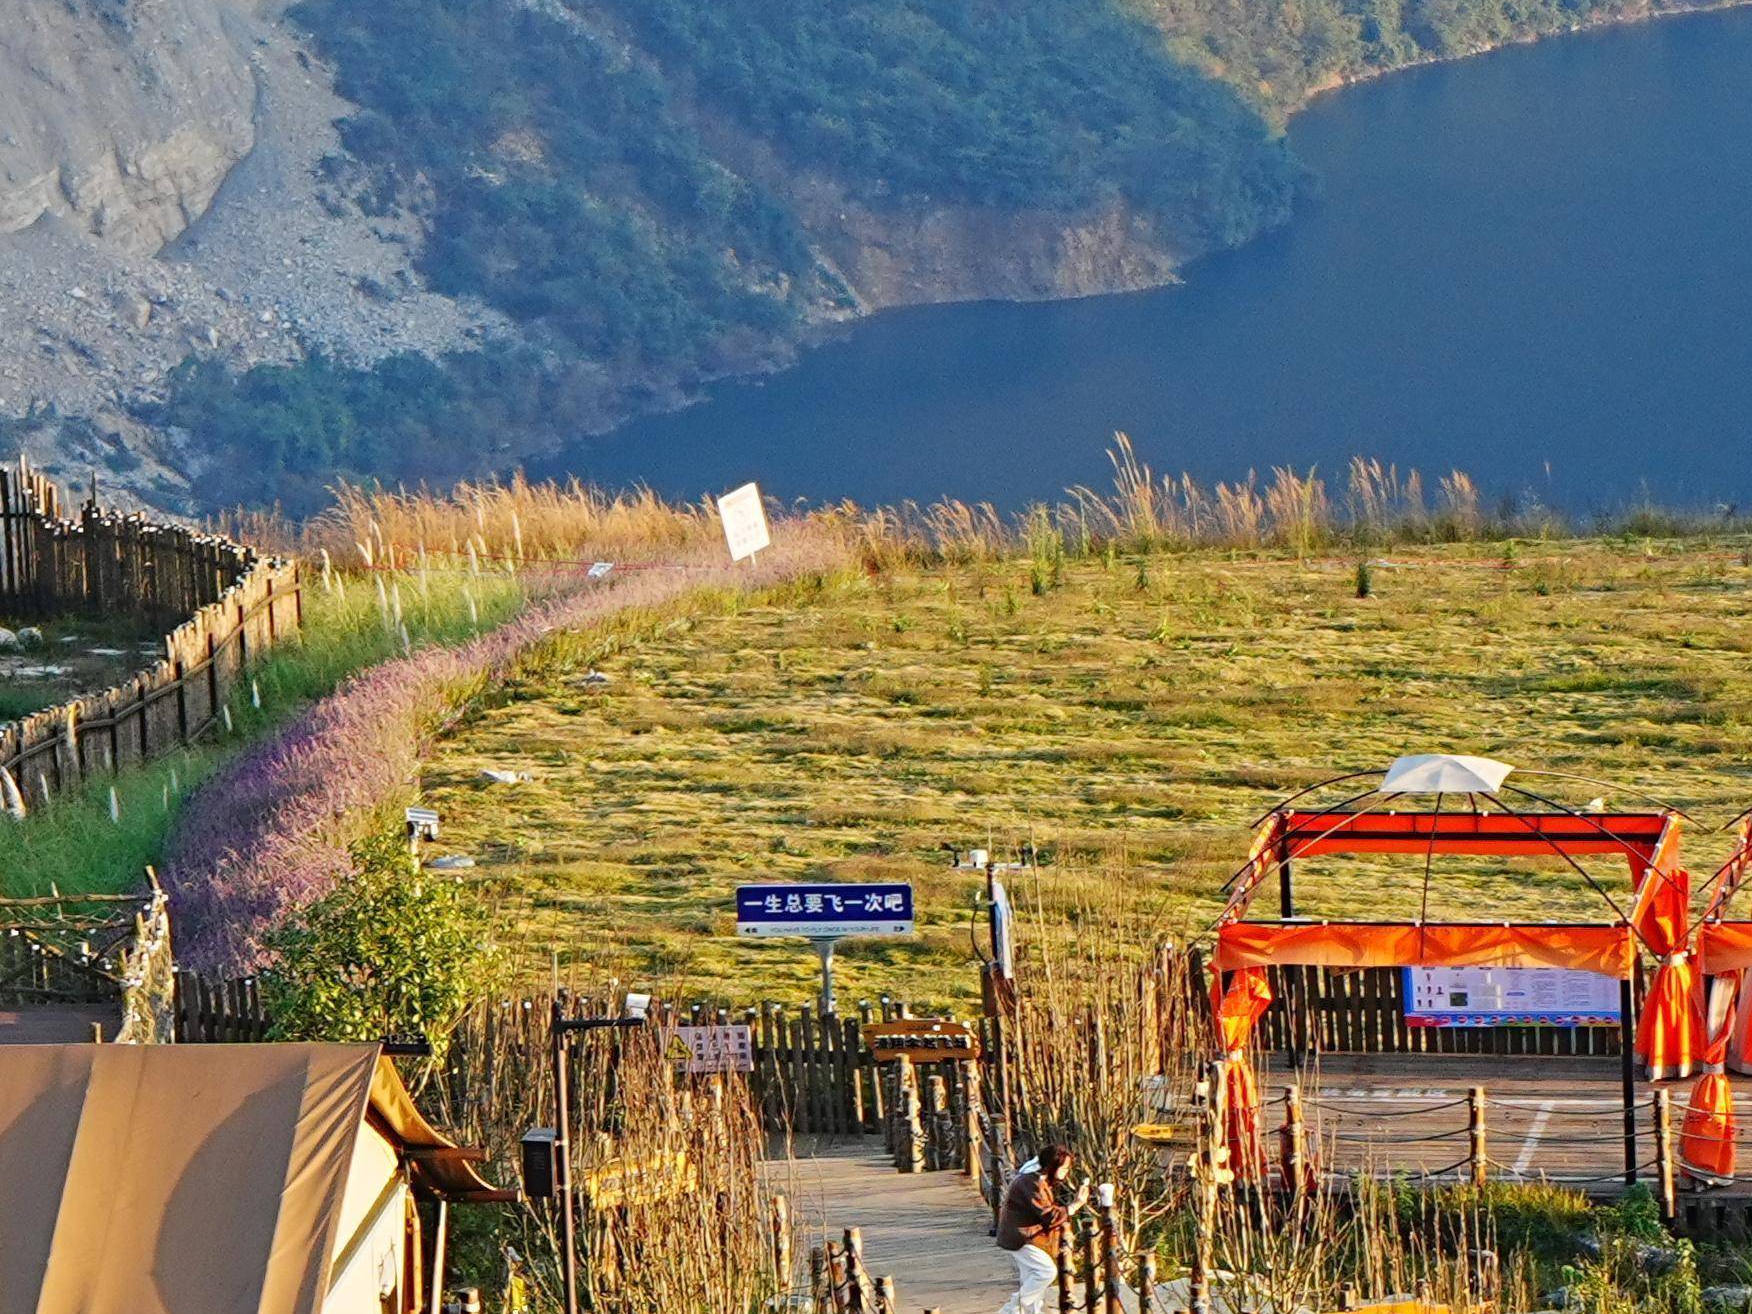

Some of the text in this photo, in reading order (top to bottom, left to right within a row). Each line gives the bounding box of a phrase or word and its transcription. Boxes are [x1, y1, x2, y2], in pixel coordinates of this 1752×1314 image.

[743, 893, 904, 914] 一生总要飞一次吧
